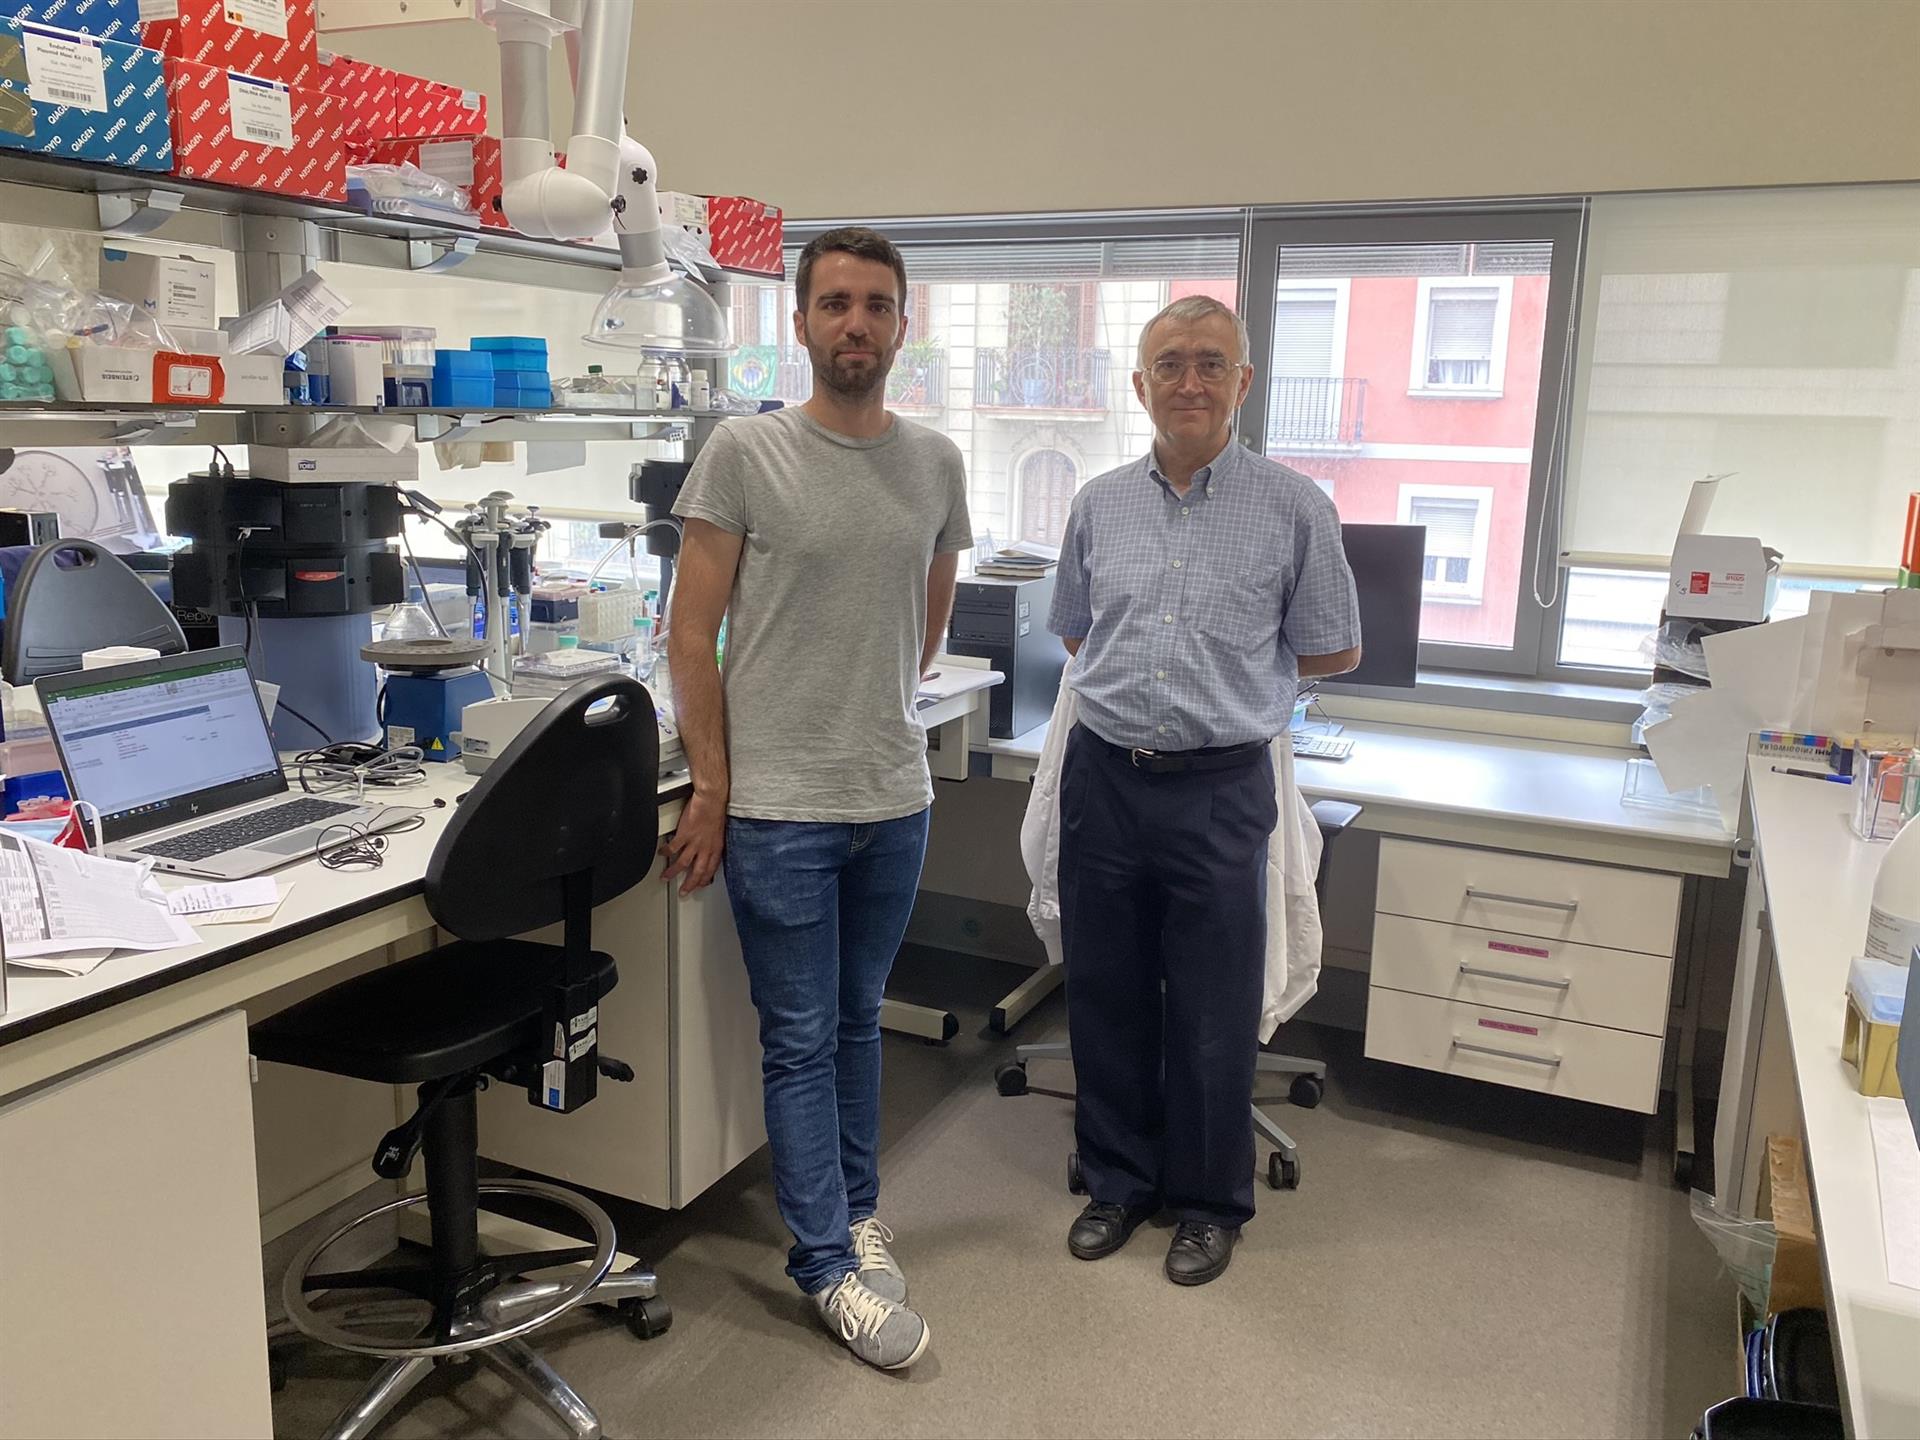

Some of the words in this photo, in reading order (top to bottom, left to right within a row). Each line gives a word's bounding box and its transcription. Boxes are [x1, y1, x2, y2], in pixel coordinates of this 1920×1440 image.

[202, 1, 222, 27] QIAGEN
[224, 26, 244, 52] QIAGEN
[299, 28, 316, 51] QIAGEN
[121, 48, 144, 73] QIAGEN
[272, 40, 291, 64] QIAGEN
[143, 75, 165, 100] QIAGEN
[199, 67, 219, 89] QIAGEN
[113, 82, 136, 107] QIAGEN
[190, 99, 211, 123] QIAGEN
[314, 96, 333, 118] QIAGEN
[103, 117, 127, 143] QIAGEN
[135, 109, 157, 134] QIAGEN
[71, 126, 96, 153] QIAGEN
[182, 132, 203, 156] QIAGEN
[210, 124, 230, 148] QIAGEN
[307, 126, 325, 149] QIAGEN
[229, 149, 249, 173] QIAGEN
[299, 158, 317, 180] QIAGEN
[324, 150, 341, 172] QIAGEN
[274, 165, 293, 188] QIAGEN
